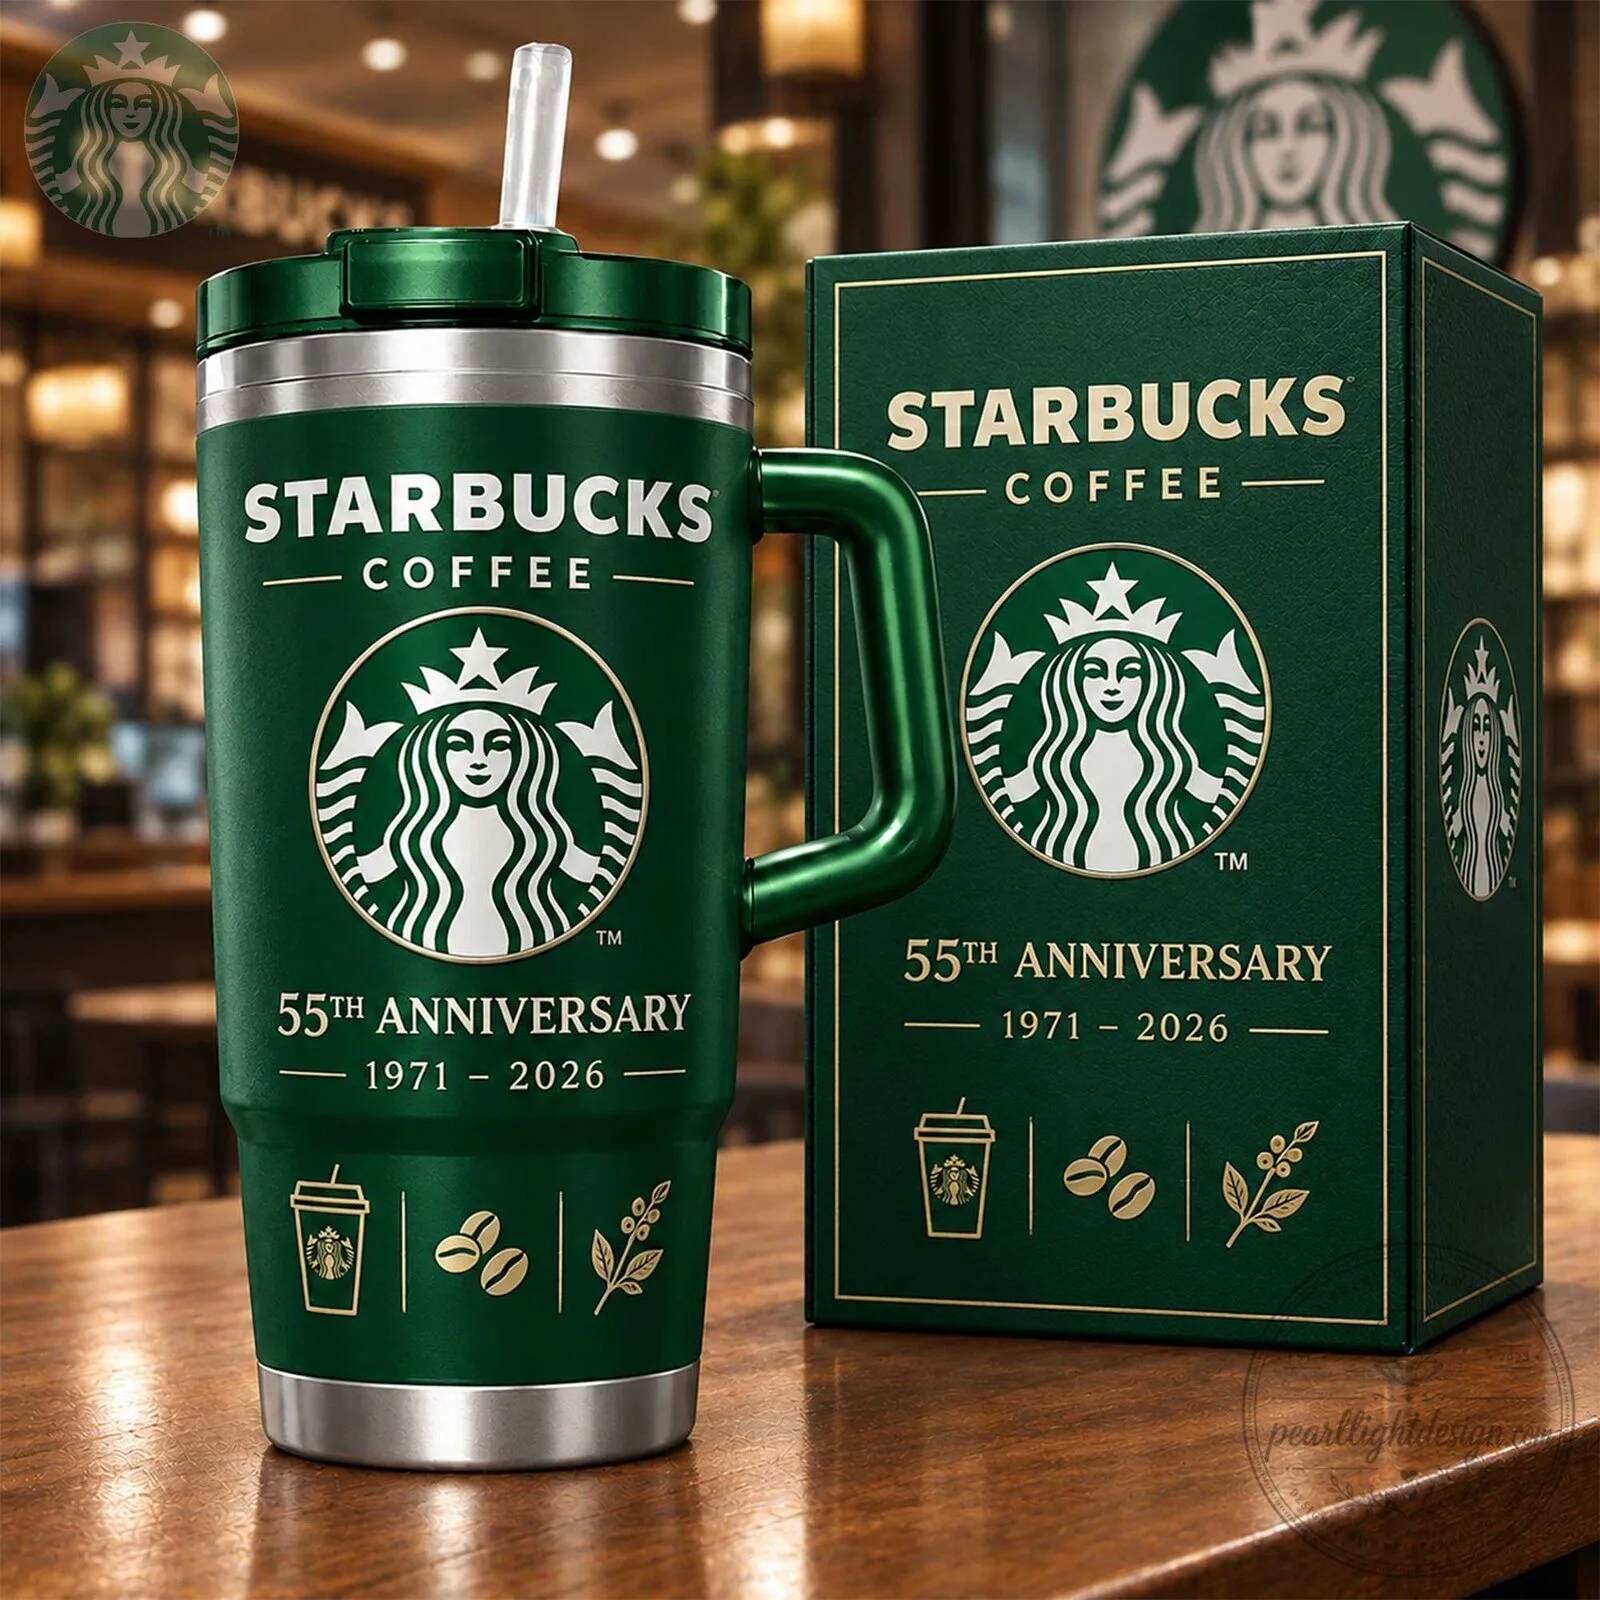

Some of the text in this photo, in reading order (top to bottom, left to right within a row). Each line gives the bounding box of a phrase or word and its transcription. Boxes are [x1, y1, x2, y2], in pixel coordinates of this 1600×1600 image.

[887, 374, 1346, 451] STARBUCKS
[1005, 466, 1221, 505] COFFEE
[243, 472, 714, 544] STARBUCKS
[362, 555, 591, 591] COFFEE
[1215, 851, 1249, 871] TM
[595, 930, 623, 946] TM
[904, 938, 1333, 983] 55TH ANNIVERSARY
[277, 992, 692, 1038] 55TH ANNIVERSARY
[1002, 1010, 1080, 1040] 1971
[1136, 1012, 1229, 1042] 2026
[366, 1060, 447, 1091] 1971
[509, 1060, 605, 1091] 2026
